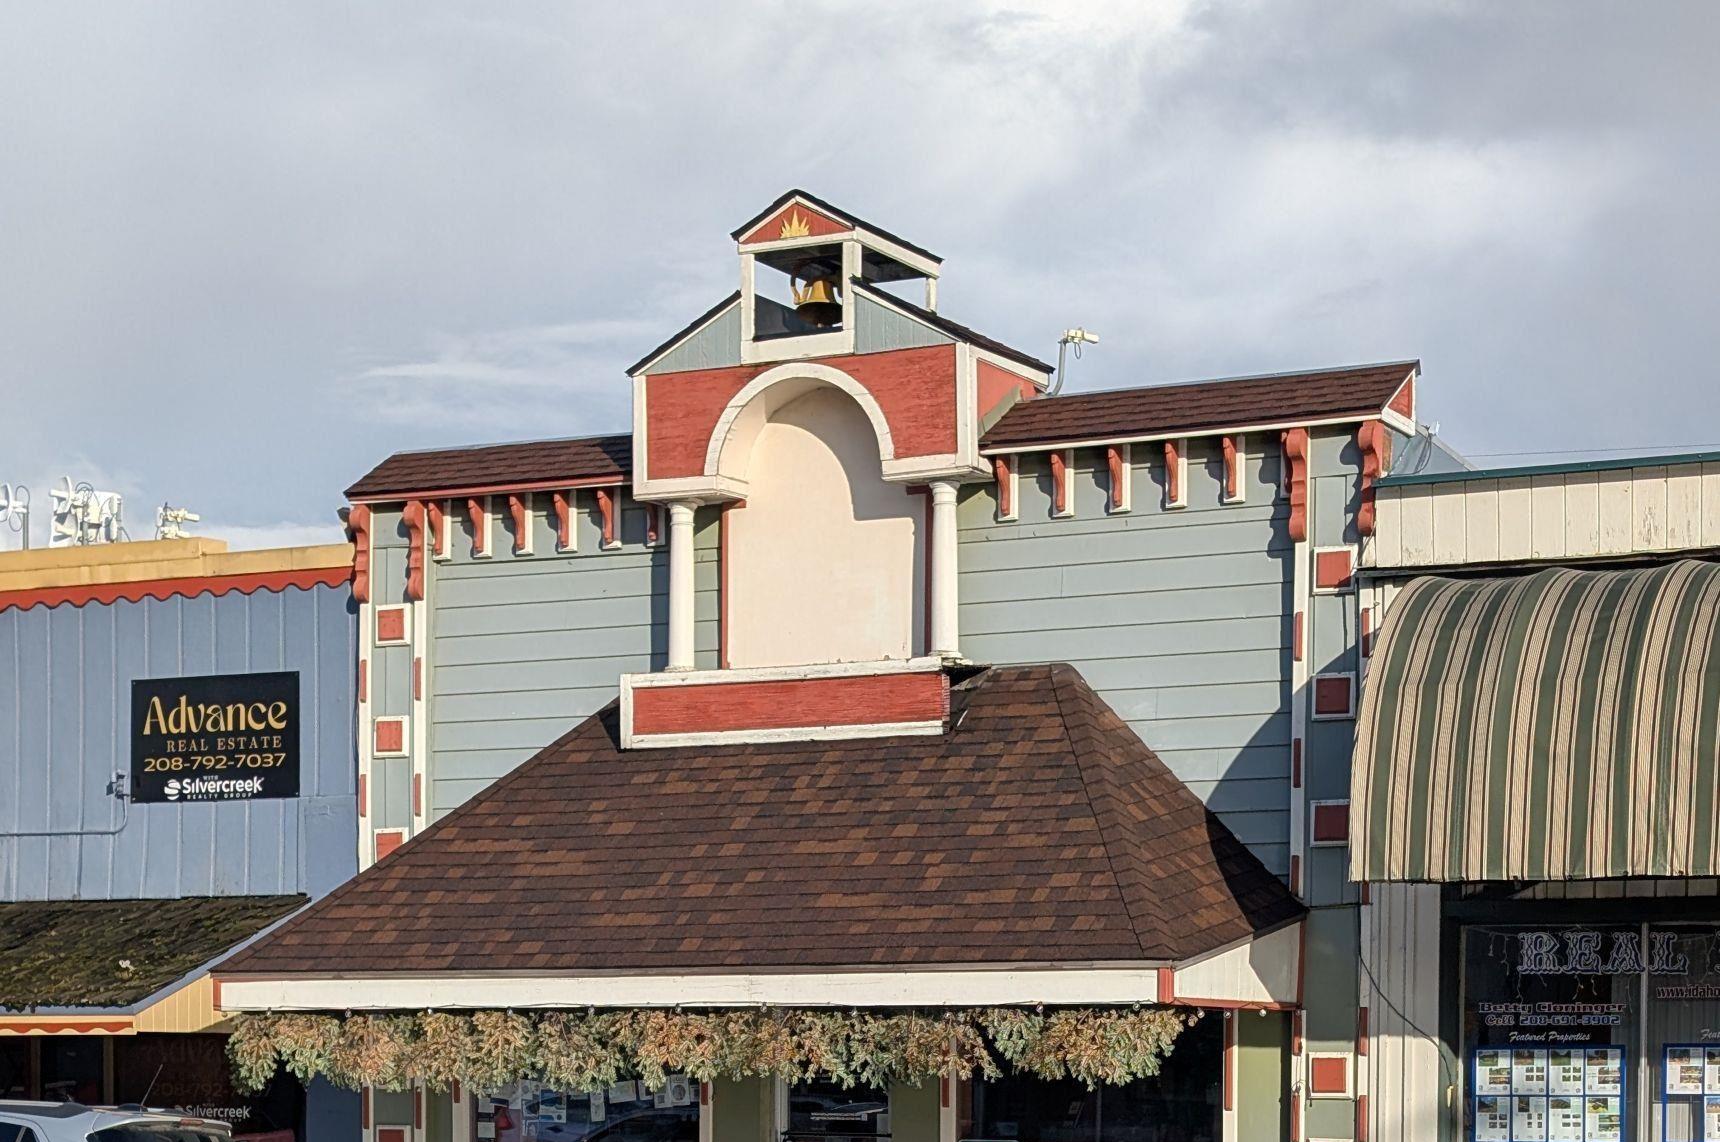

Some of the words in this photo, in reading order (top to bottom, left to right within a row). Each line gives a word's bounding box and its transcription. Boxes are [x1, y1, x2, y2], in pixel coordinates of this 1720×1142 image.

[143, 695, 287, 735] Advance
[167, 739, 208, 753] REAL
[217, 736, 282, 751] ESTATE
[144, 753, 286, 772] 208-792-7037
[182, 776, 264, 794] Silvercreek
[1517, 931, 1688, 975] REAL
[1656, 984, 1720, 998] www.idaho
[1478, 1002, 1534, 1014] Betty
[1536, 1002, 1627, 1014] Cloninger
[1485, 1015, 1515, 1026] Cell
[1508, 1031, 1546, 1042] Featured
[1548, 1031, 1591, 1043] Properties
[185, 1105, 251, 1119] Silvercreek
